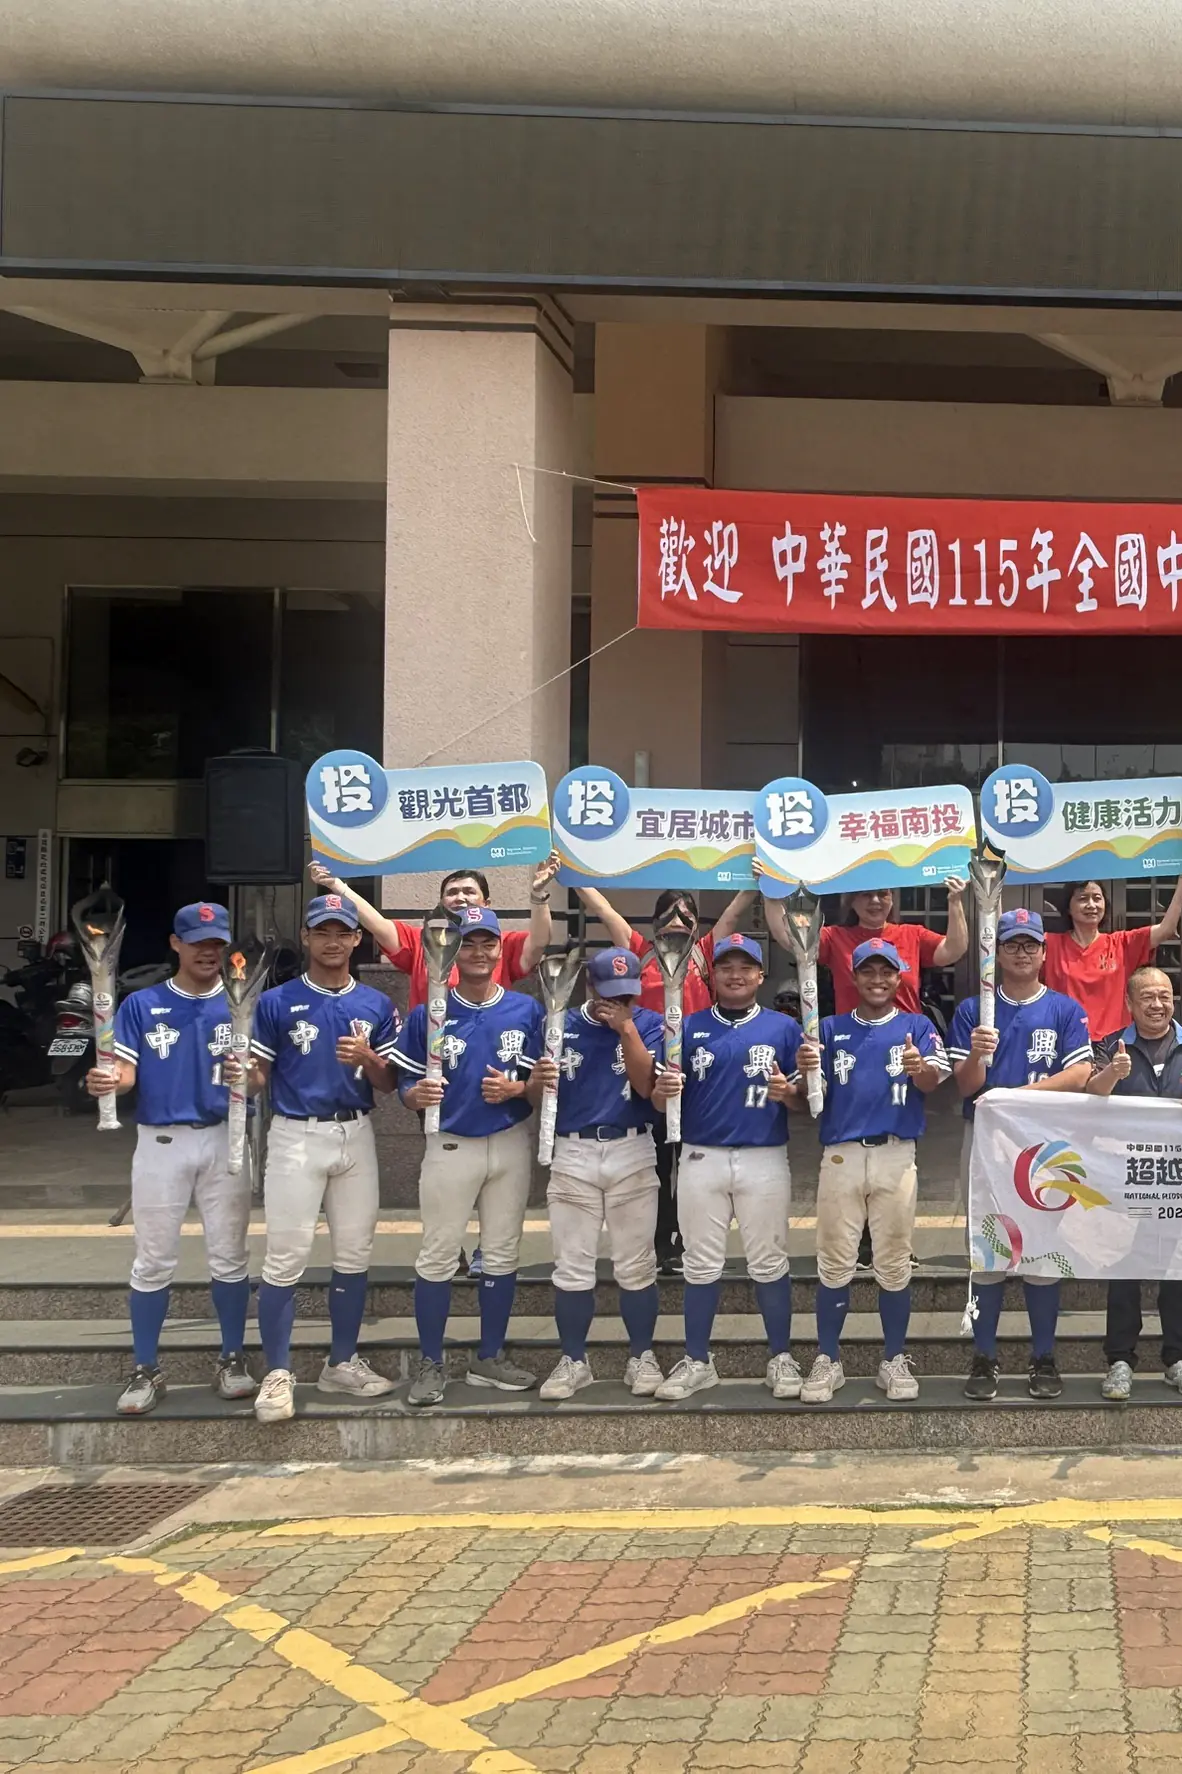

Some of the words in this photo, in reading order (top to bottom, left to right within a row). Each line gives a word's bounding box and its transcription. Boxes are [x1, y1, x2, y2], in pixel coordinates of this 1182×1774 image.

[657, 514, 743, 604] 歡迎
[320, 764, 373, 813] 投
[398, 782, 530, 821] 觀光首都
[567, 779, 614, 826] 投
[993, 778, 1038, 824] 投
[635, 808, 755, 841] 宜居城市
[766, 790, 815, 837] 投
[838, 803, 965, 842] 幸福南投
[1062, 797, 1182, 833] 健康活力
[198, 903, 215, 921] S
[466, 907, 483, 923] S
[612, 956, 627, 976] S
[145, 1022, 180, 1059] 中
[288, 1020, 319, 1055] 中
[690, 1046, 715, 1081] 中
[834, 1049, 856, 1085] 中
[745, 1085, 768, 1108] 17
